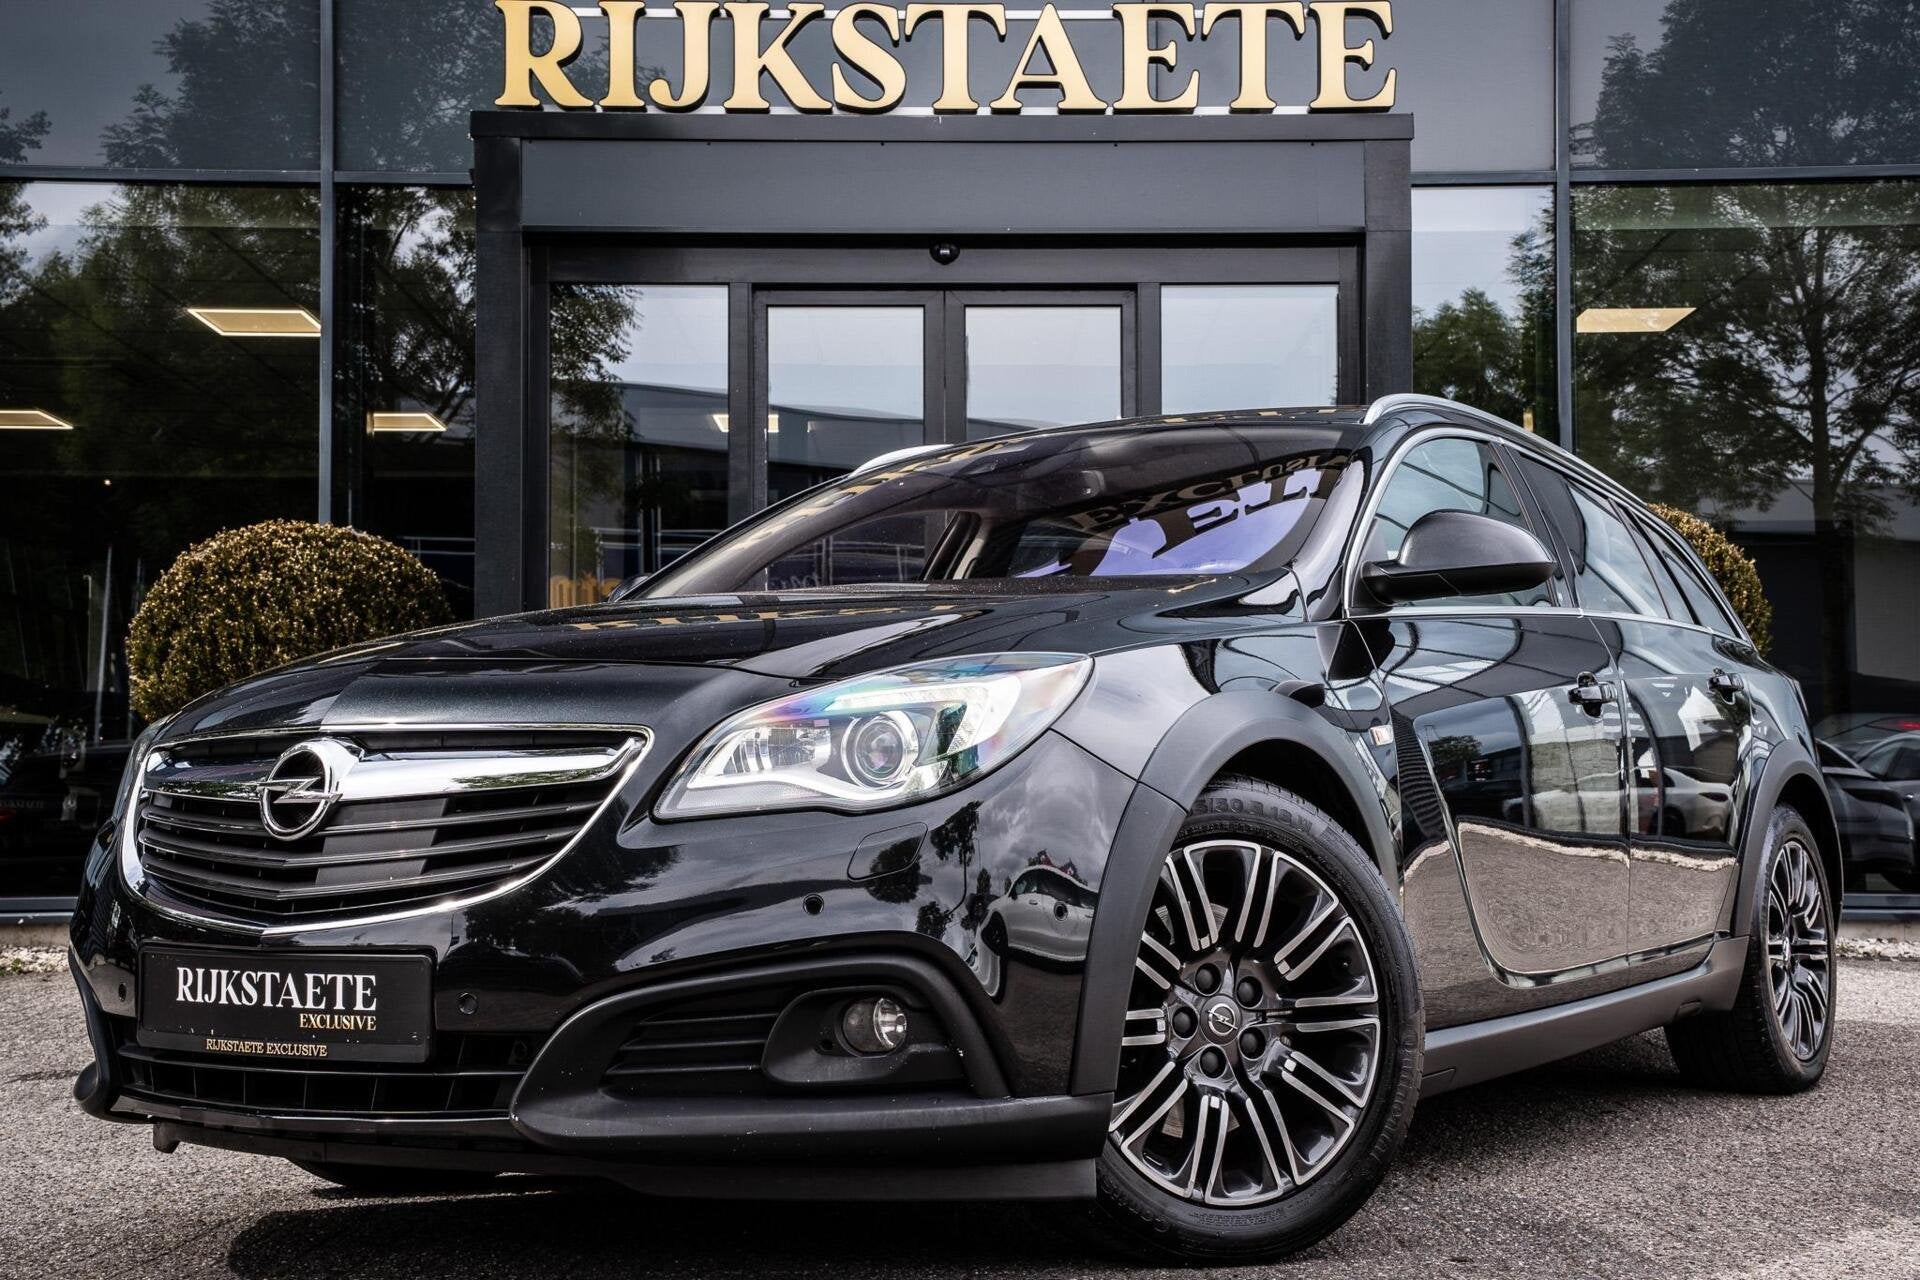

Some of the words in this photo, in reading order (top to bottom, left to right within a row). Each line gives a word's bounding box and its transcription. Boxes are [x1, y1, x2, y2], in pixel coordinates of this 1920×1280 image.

[494, 0, 1397, 113] RIJKSTAETE
[176, 966, 377, 1011] RIJKSTAETE
[299, 1013, 377, 1031] EXCLUSIVE
[205, 1038, 264, 1055] RIJKSTAETE
[266, 1042, 328, 1057] EXCLUSIVE
